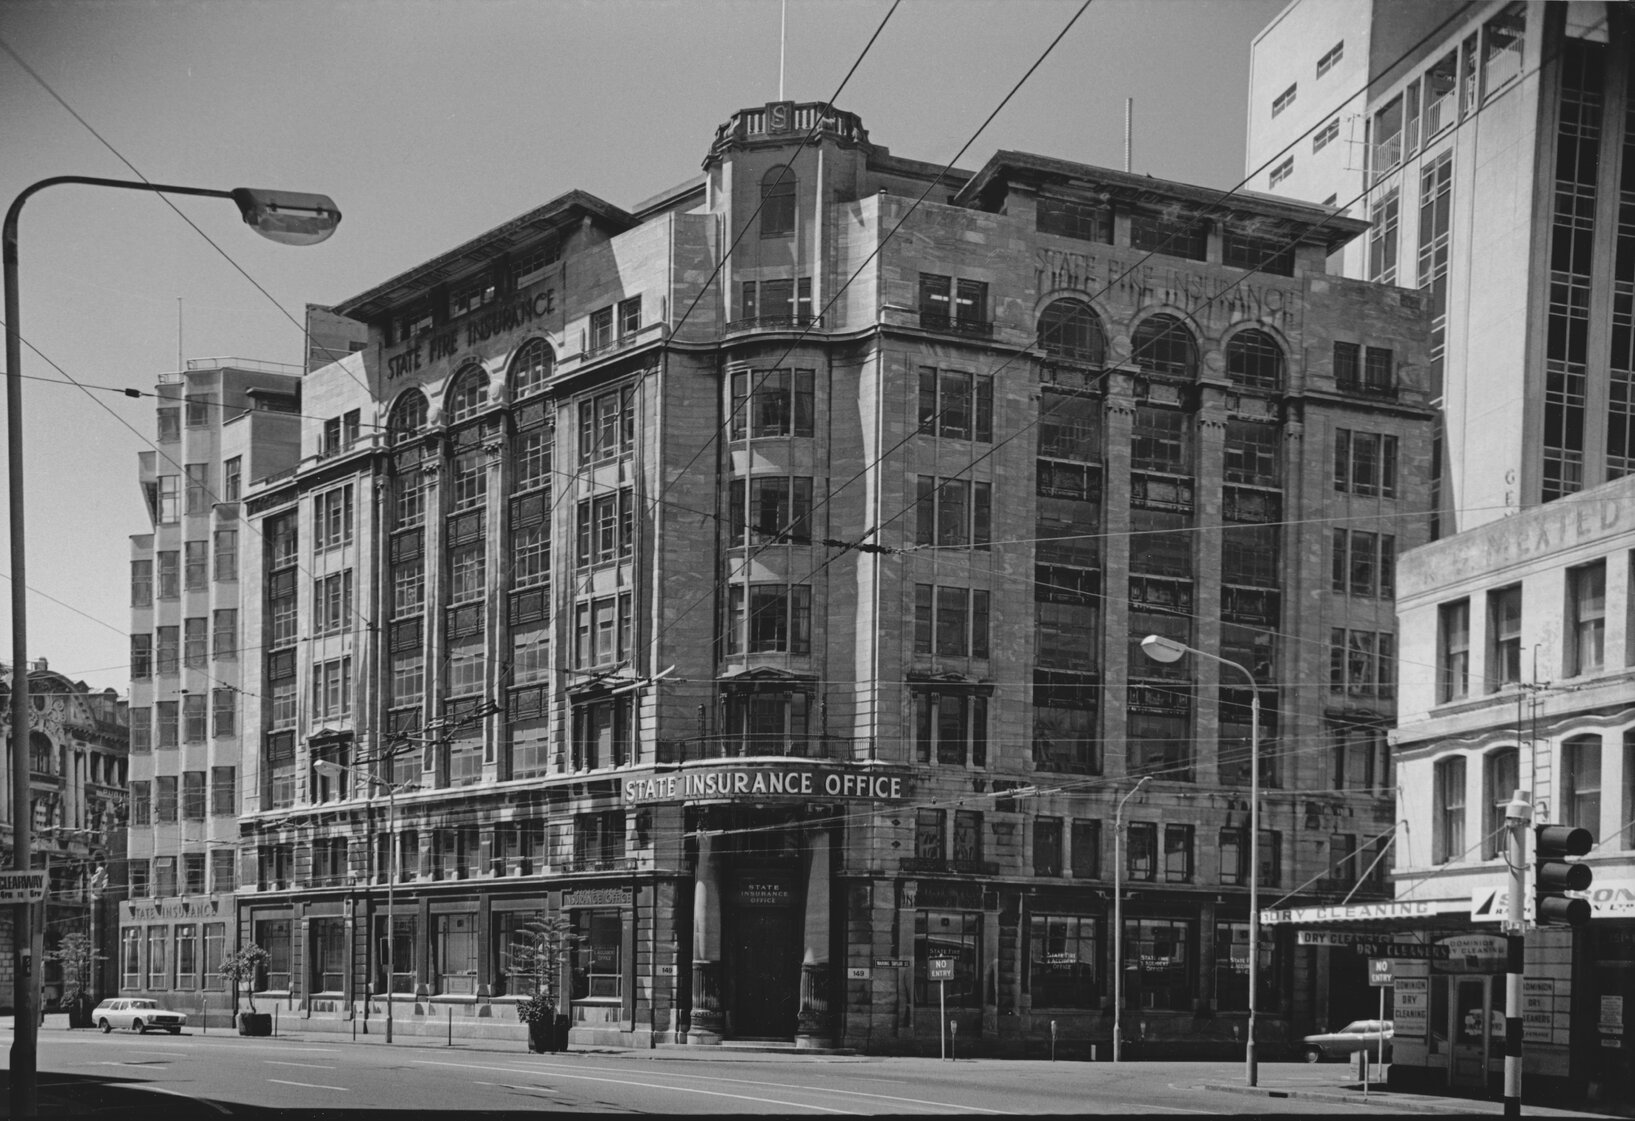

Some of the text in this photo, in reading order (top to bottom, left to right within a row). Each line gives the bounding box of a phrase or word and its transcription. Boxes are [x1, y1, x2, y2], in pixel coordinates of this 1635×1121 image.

[770, 104, 788, 128] S
[387, 288, 556, 380] STATE FIRE INSURANCE
[625, 772, 901, 802] STATE INSURANCE OFFICE
[1270, 910, 1306, 921] DRY
[1316, 902, 1429, 919] CLEANING
[1304, 932, 1325, 943] DRY
[1357, 944, 1378, 955] DRY
[1387, 944, 1447, 957] CLEANERS
[935, 960, 947, 969] NO
[1375, 961, 1388, 971] NO
[931, 969, 951, 977] ENTRY
[1371, 973, 1392, 982] ENTRY
[1396, 981, 1426, 990] DOMINION
[1402, 995, 1418, 1004] DRY
[1396, 1010, 1426, 1018] CLEANING
